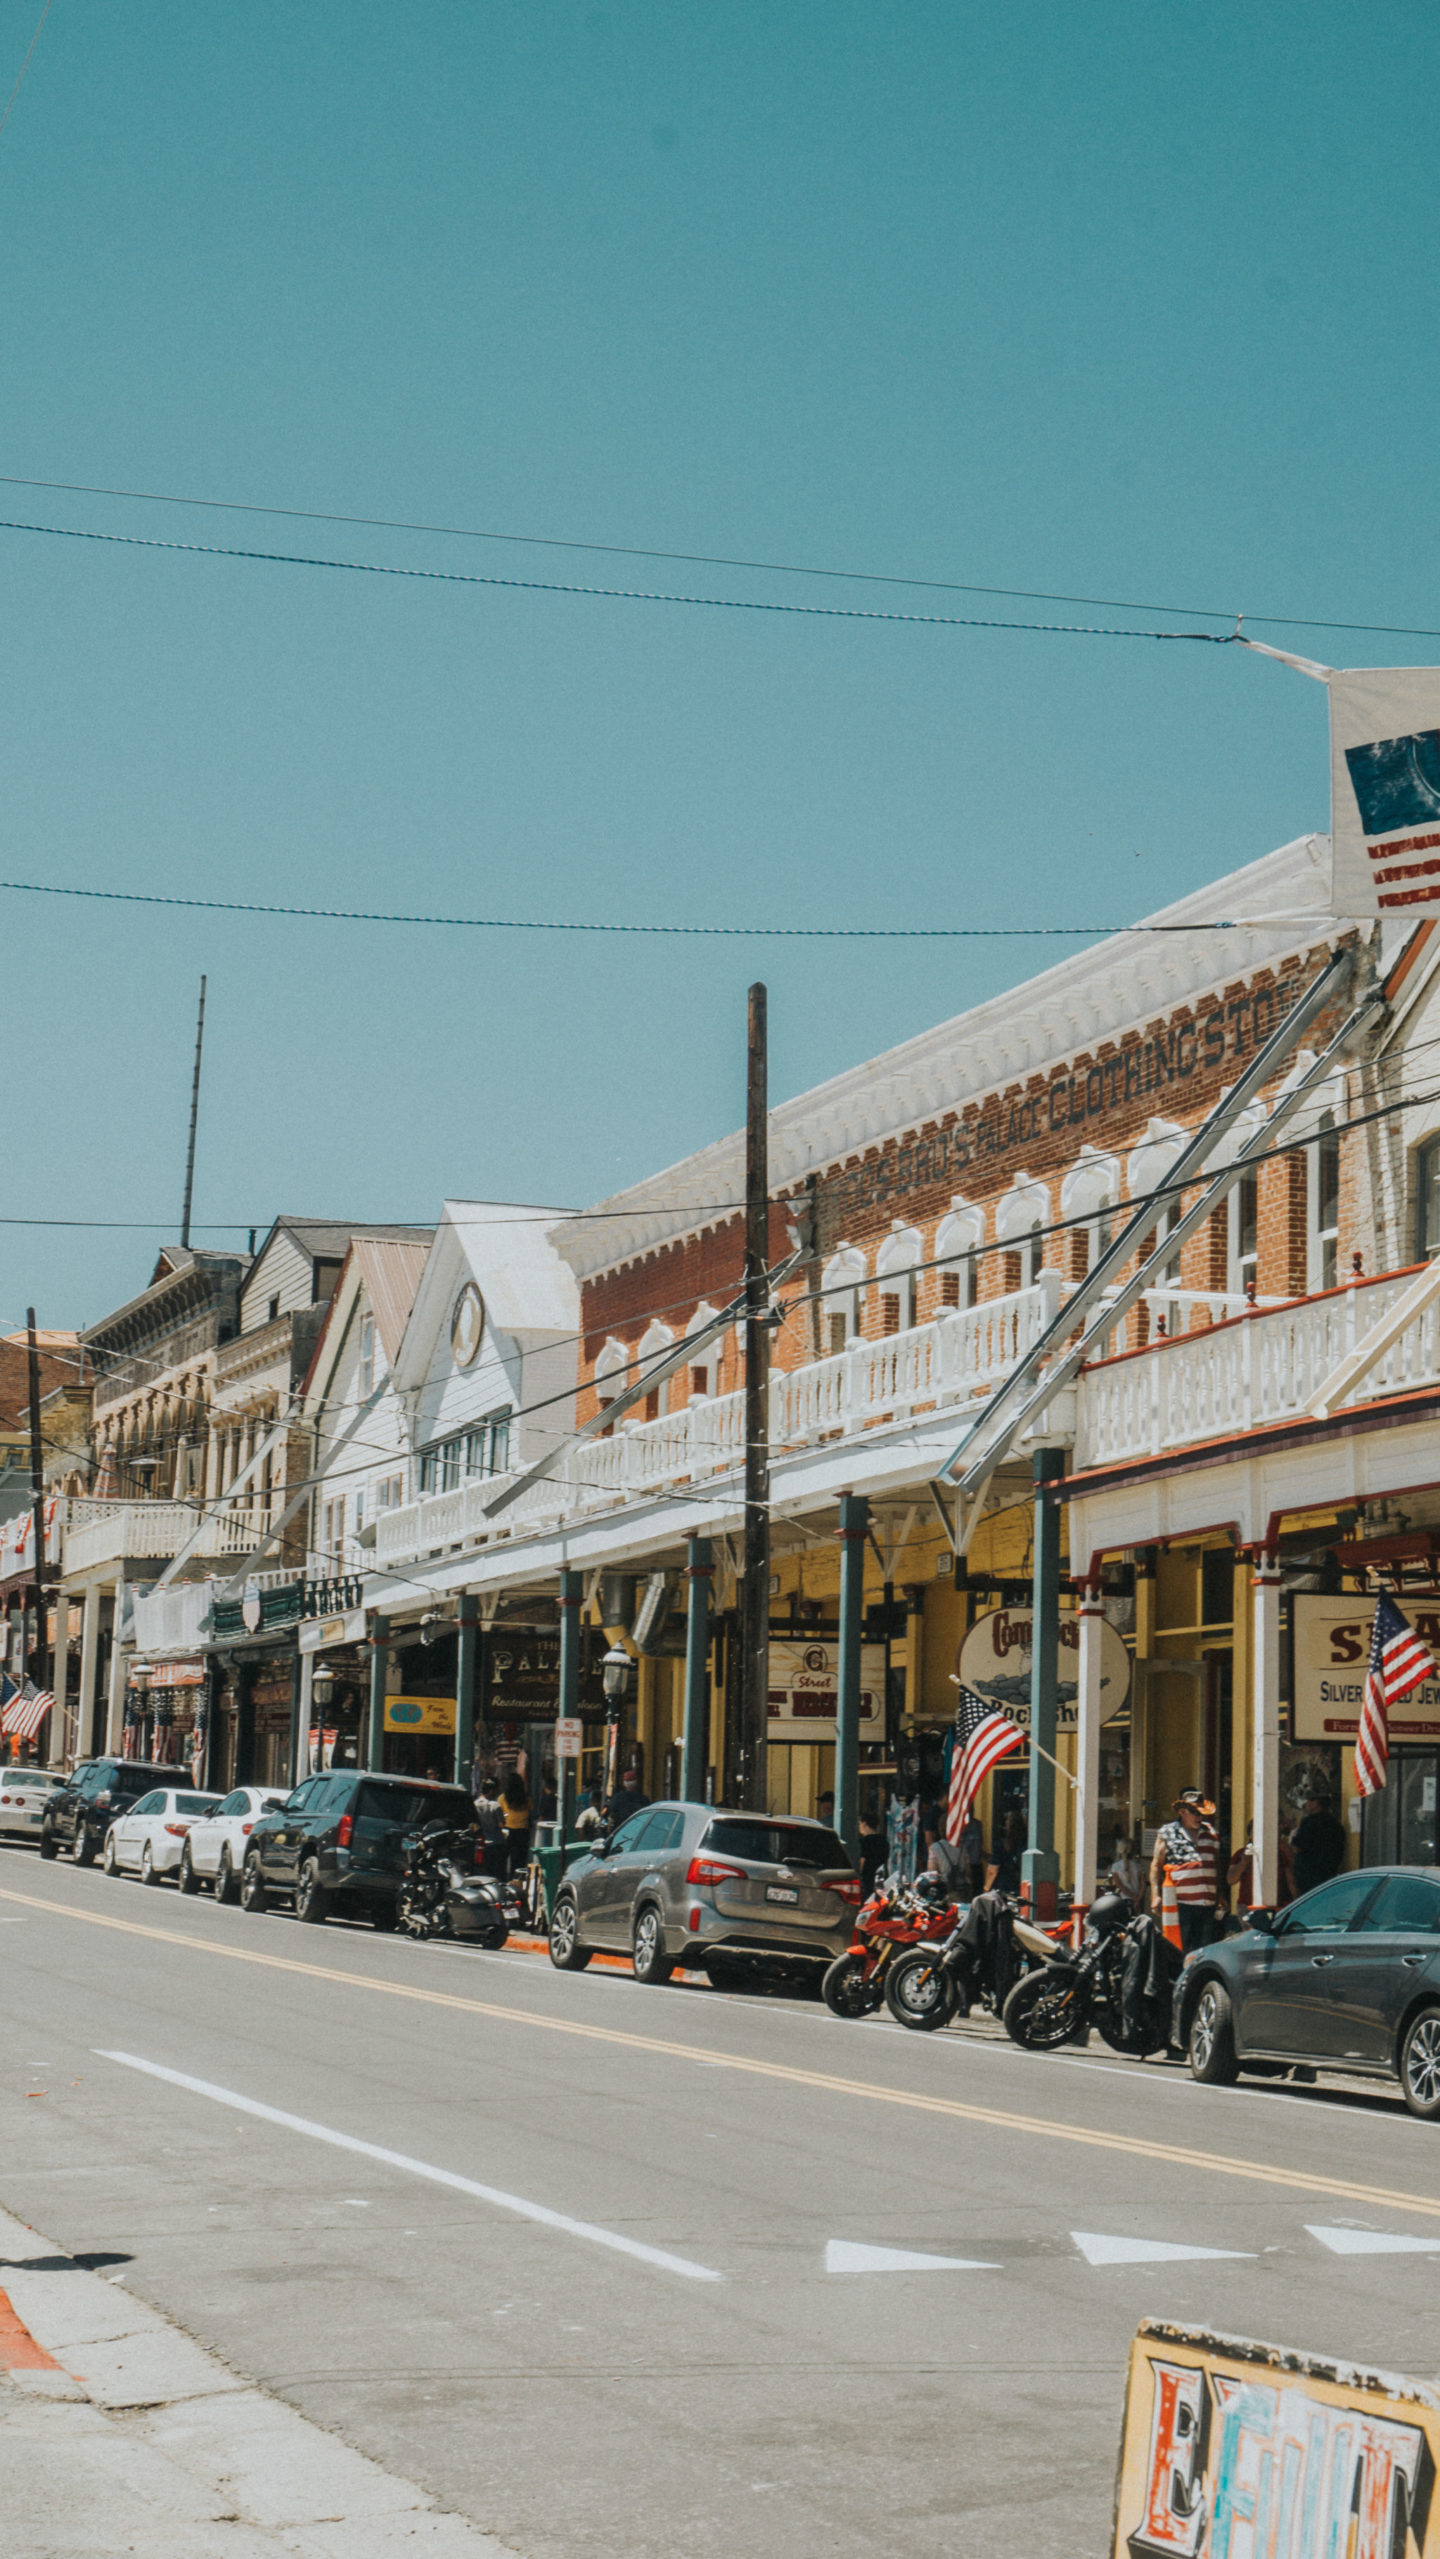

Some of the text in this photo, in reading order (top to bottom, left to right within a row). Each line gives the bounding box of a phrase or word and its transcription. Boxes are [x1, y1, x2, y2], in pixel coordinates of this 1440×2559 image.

[976, 1096, 1042, 1160] PALACE
[1048, 1021, 1198, 1131] CLOTHING
[799, 1676, 832, 1688] Street
[491, 1696, 551, 1709] Restaurant
